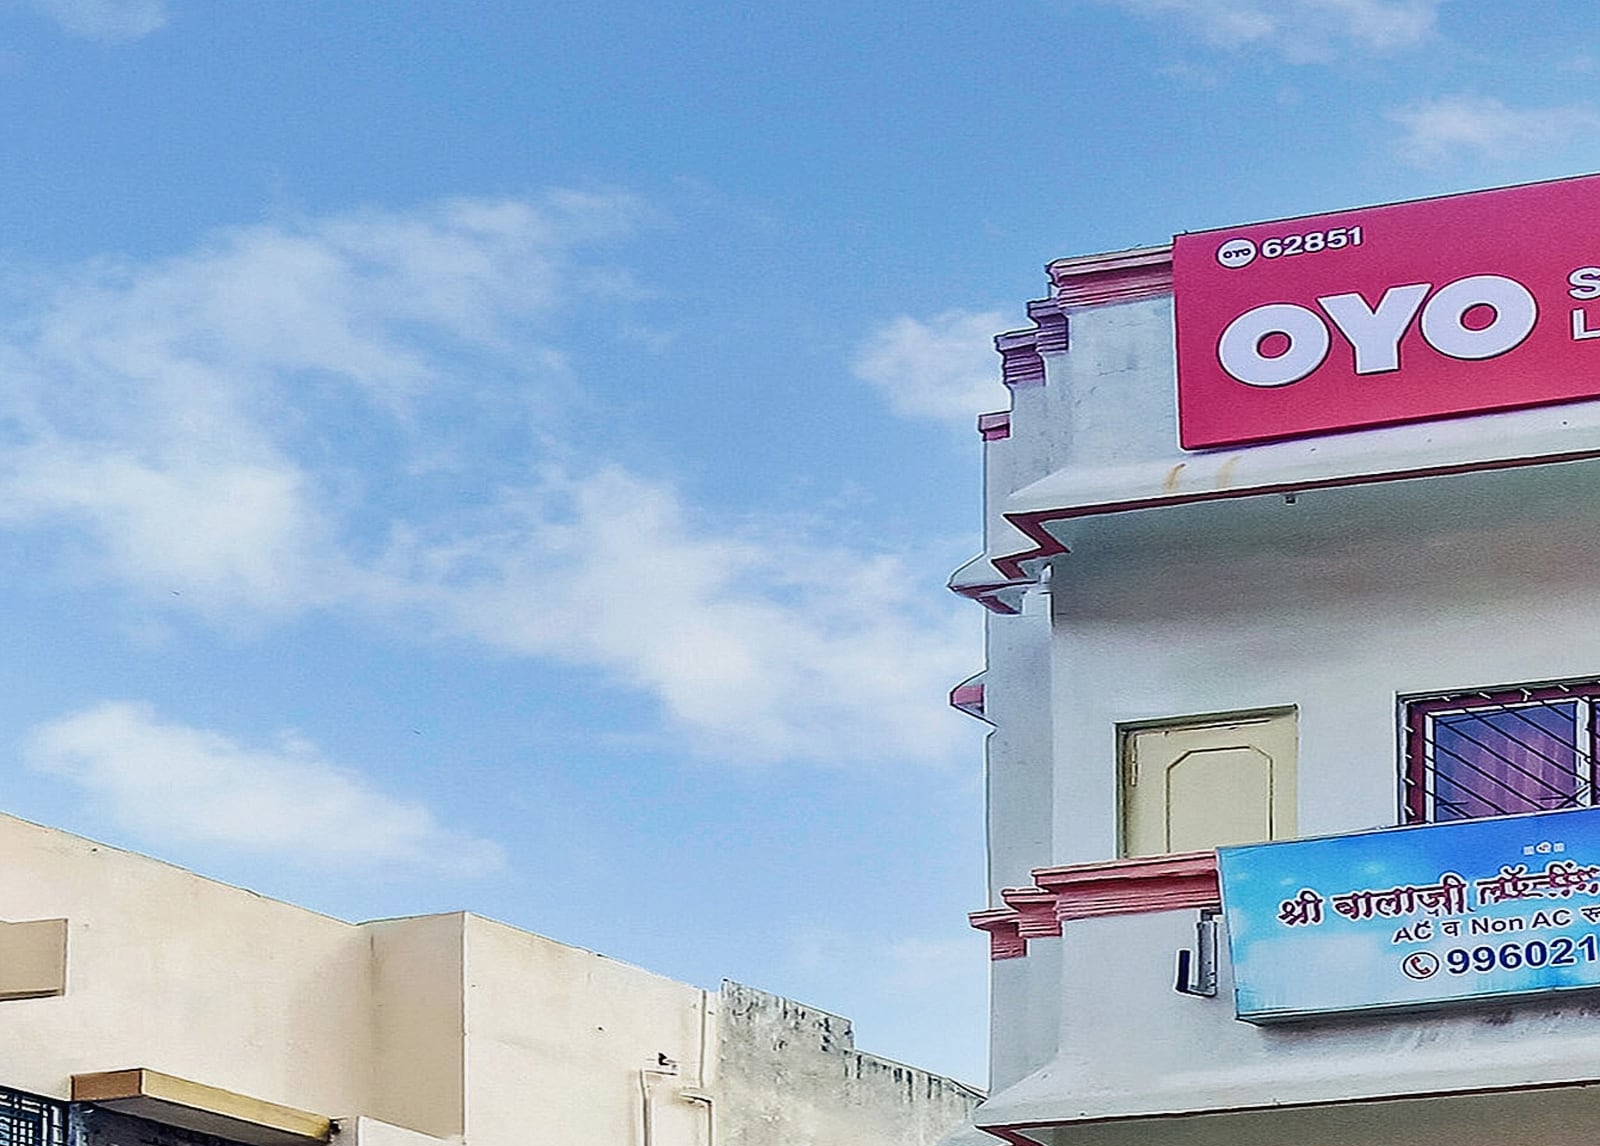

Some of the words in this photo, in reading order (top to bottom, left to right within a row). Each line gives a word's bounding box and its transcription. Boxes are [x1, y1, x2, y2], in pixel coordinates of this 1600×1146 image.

[1261, 226, 1362, 259] 62851
[1218, 274, 1538, 387] OYO
[1278, 889, 1324, 926] श्री
[1393, 920, 1433, 943] AC
[1442, 920, 1461, 938] व
[1471, 915, 1524, 936] Non
[1531, 909, 1571, 929] AC
